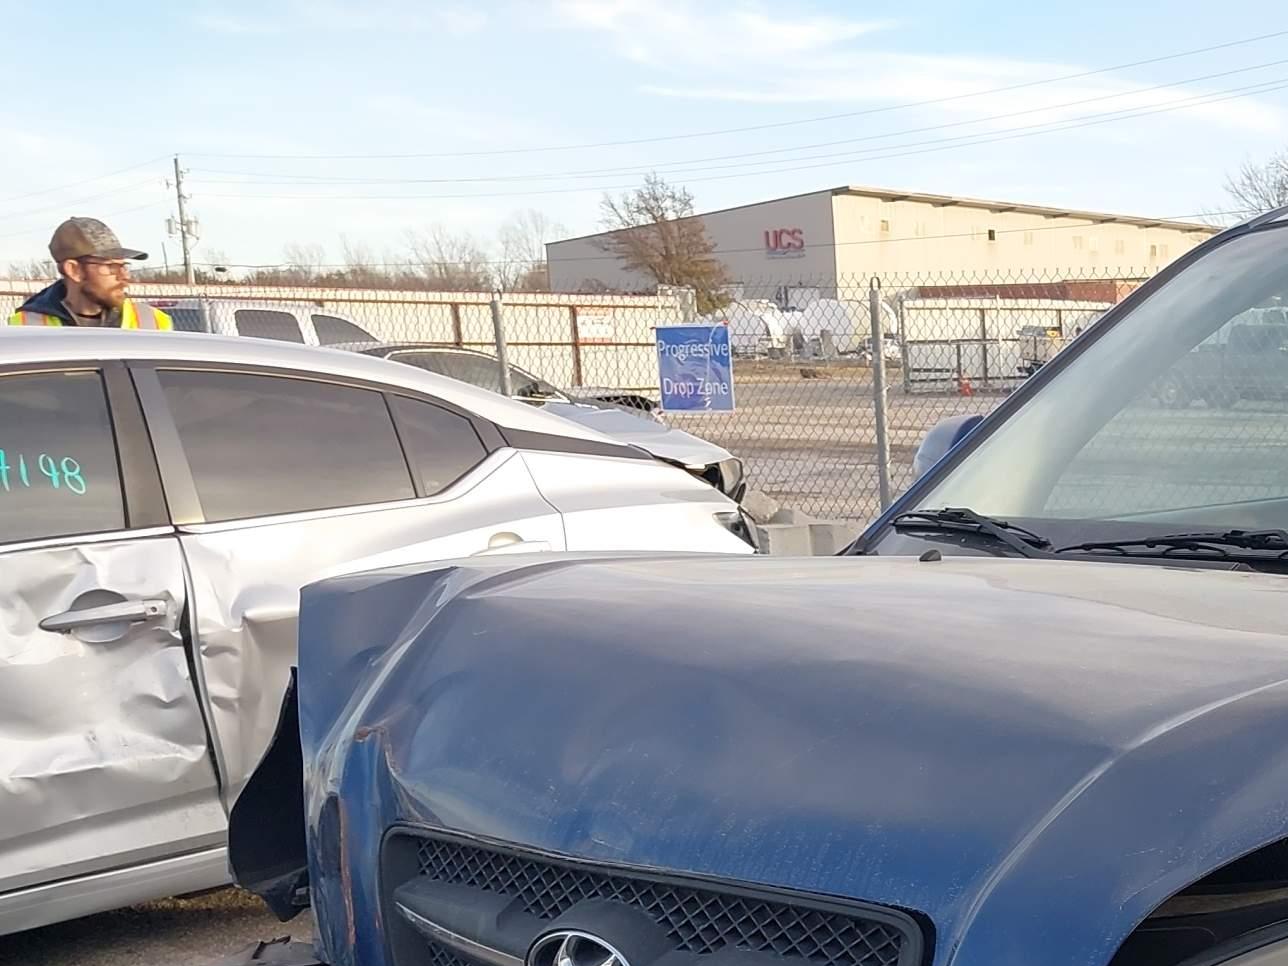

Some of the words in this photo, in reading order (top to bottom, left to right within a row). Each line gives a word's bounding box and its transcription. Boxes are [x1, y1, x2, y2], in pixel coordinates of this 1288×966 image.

[764, 228, 805, 251] UCS
[658, 340, 729, 361] Progressive
[663, 377, 695, 398] Drop
[696, 377, 729, 396] Zone
